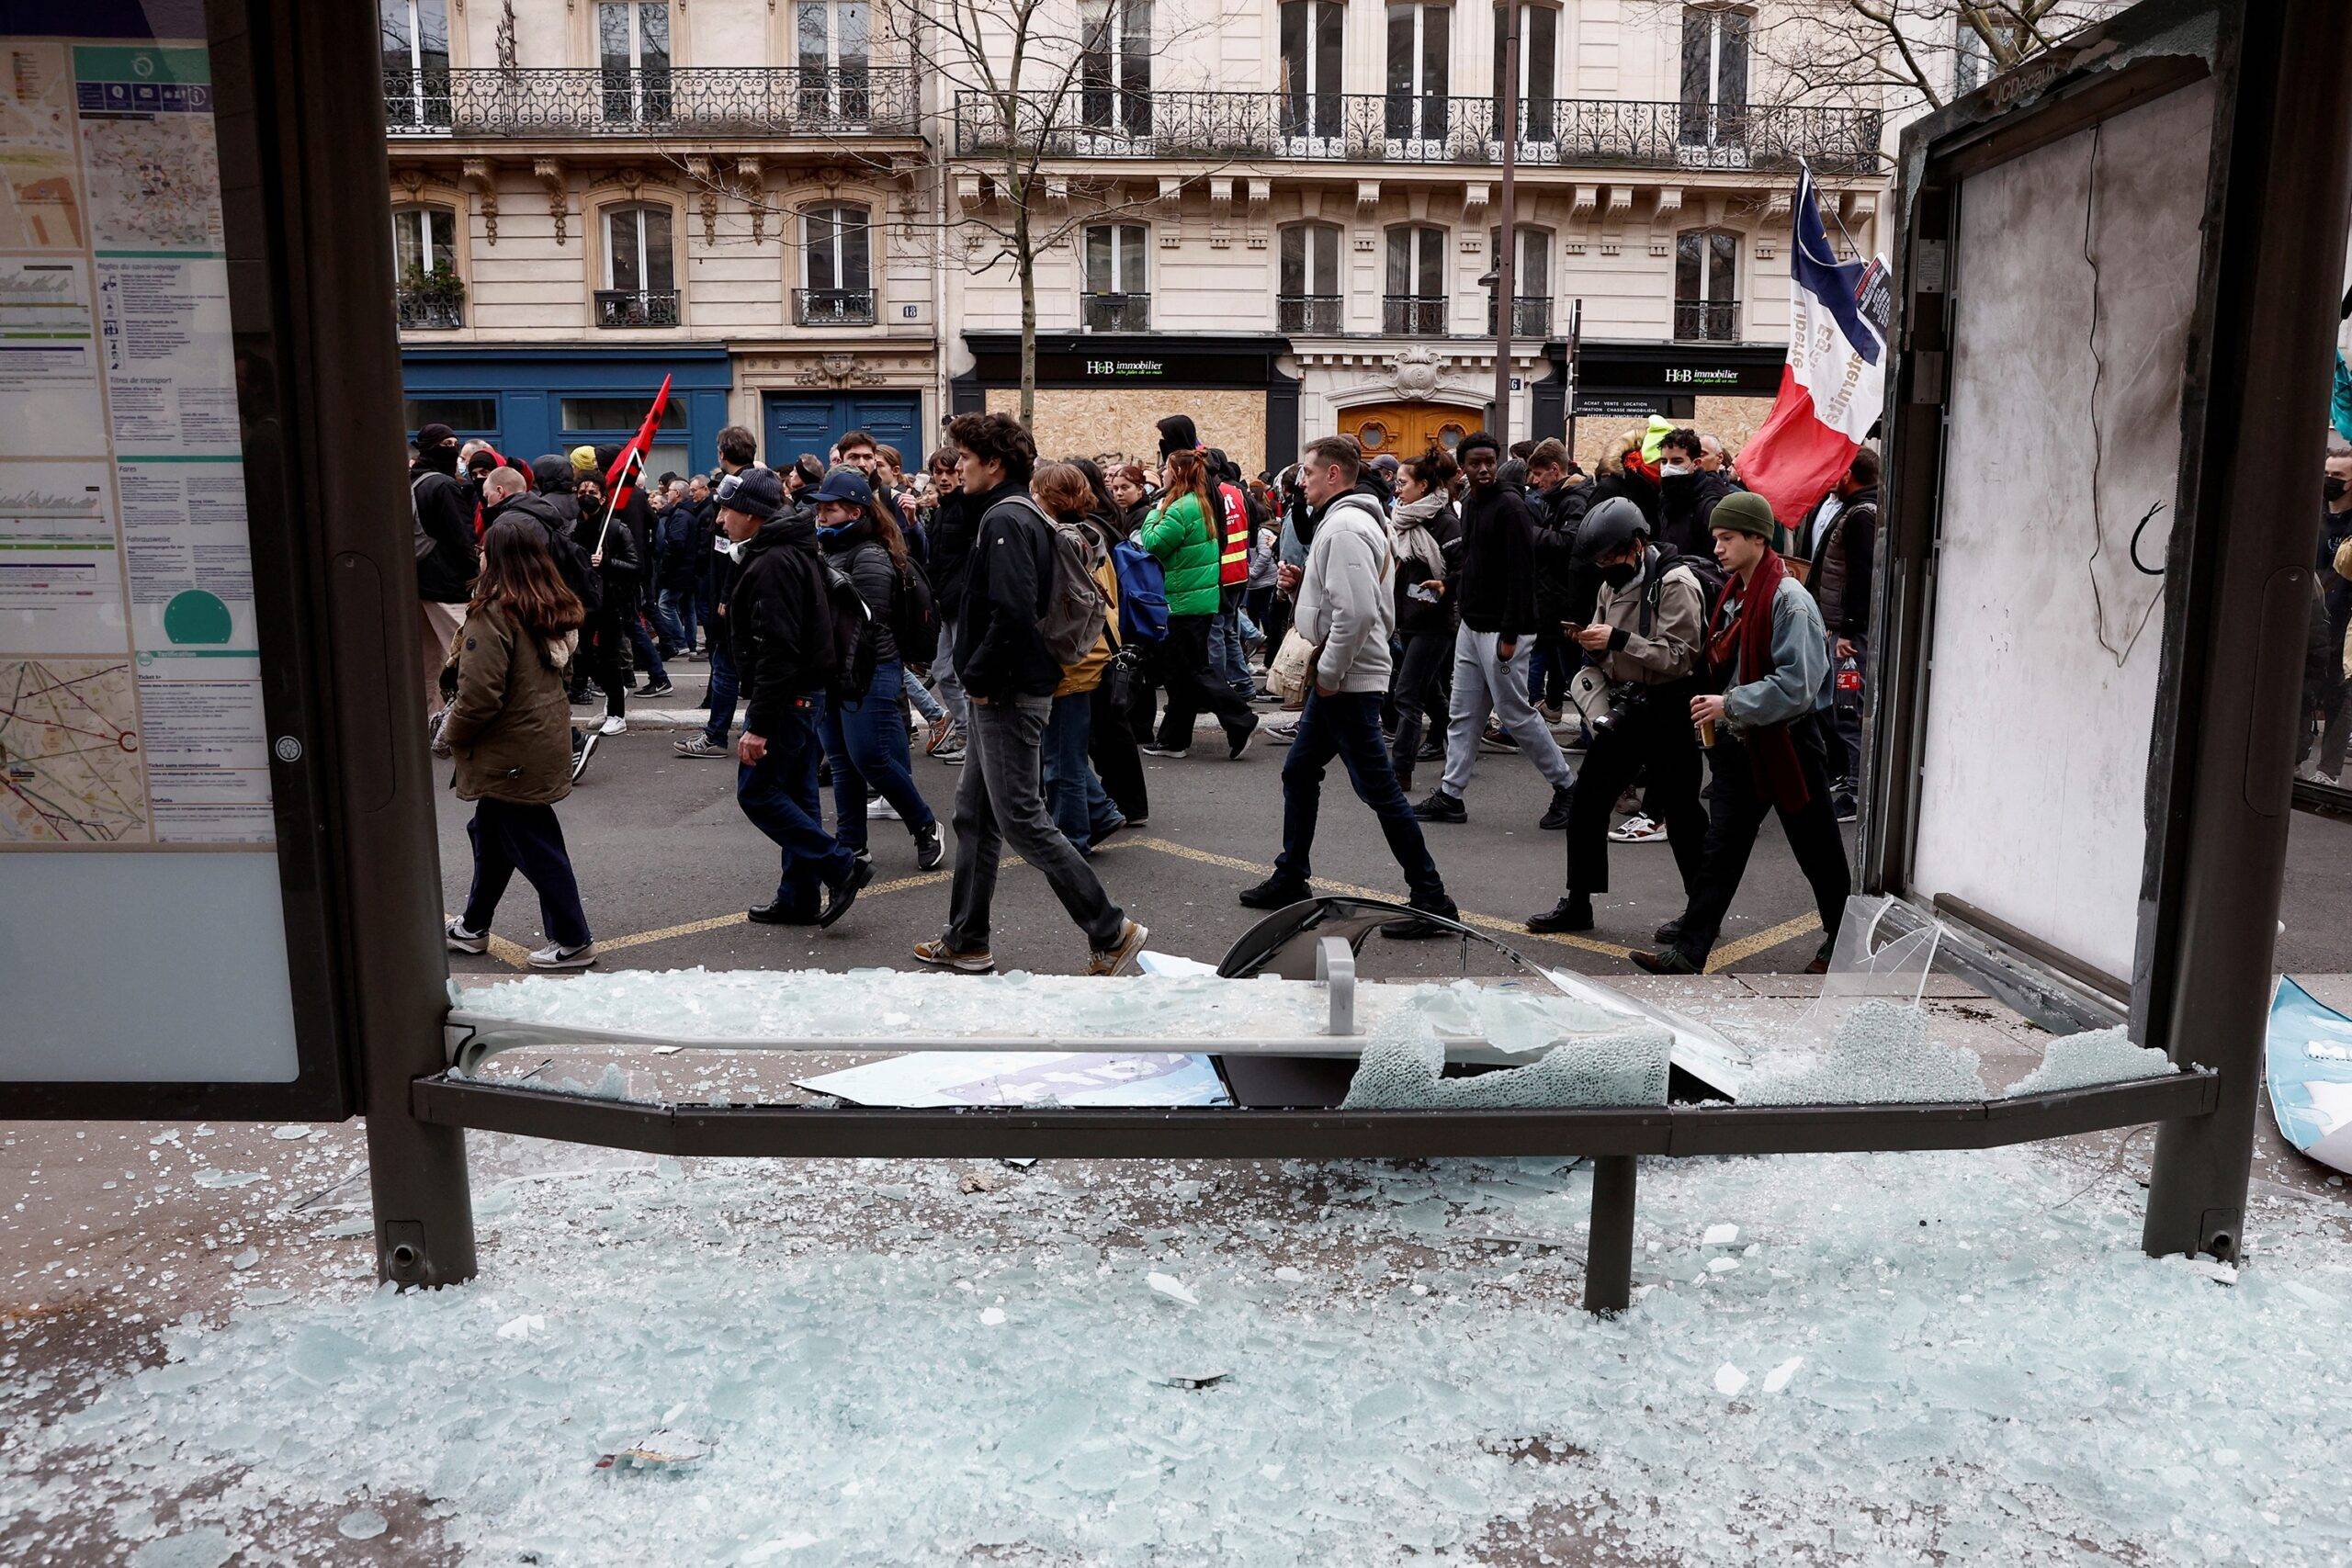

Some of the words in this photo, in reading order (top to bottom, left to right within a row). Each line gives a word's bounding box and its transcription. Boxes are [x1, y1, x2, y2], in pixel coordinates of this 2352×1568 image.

[1994, 62, 2058, 107] JCDecaux
[905, 307, 916, 317] 18
[1087, 361, 1114, 375] H&B
[1116, 361, 1162, 370] immobilier
[1665, 368, 1691, 383] H&B
[1694, 369, 1738, 378] immobilier
